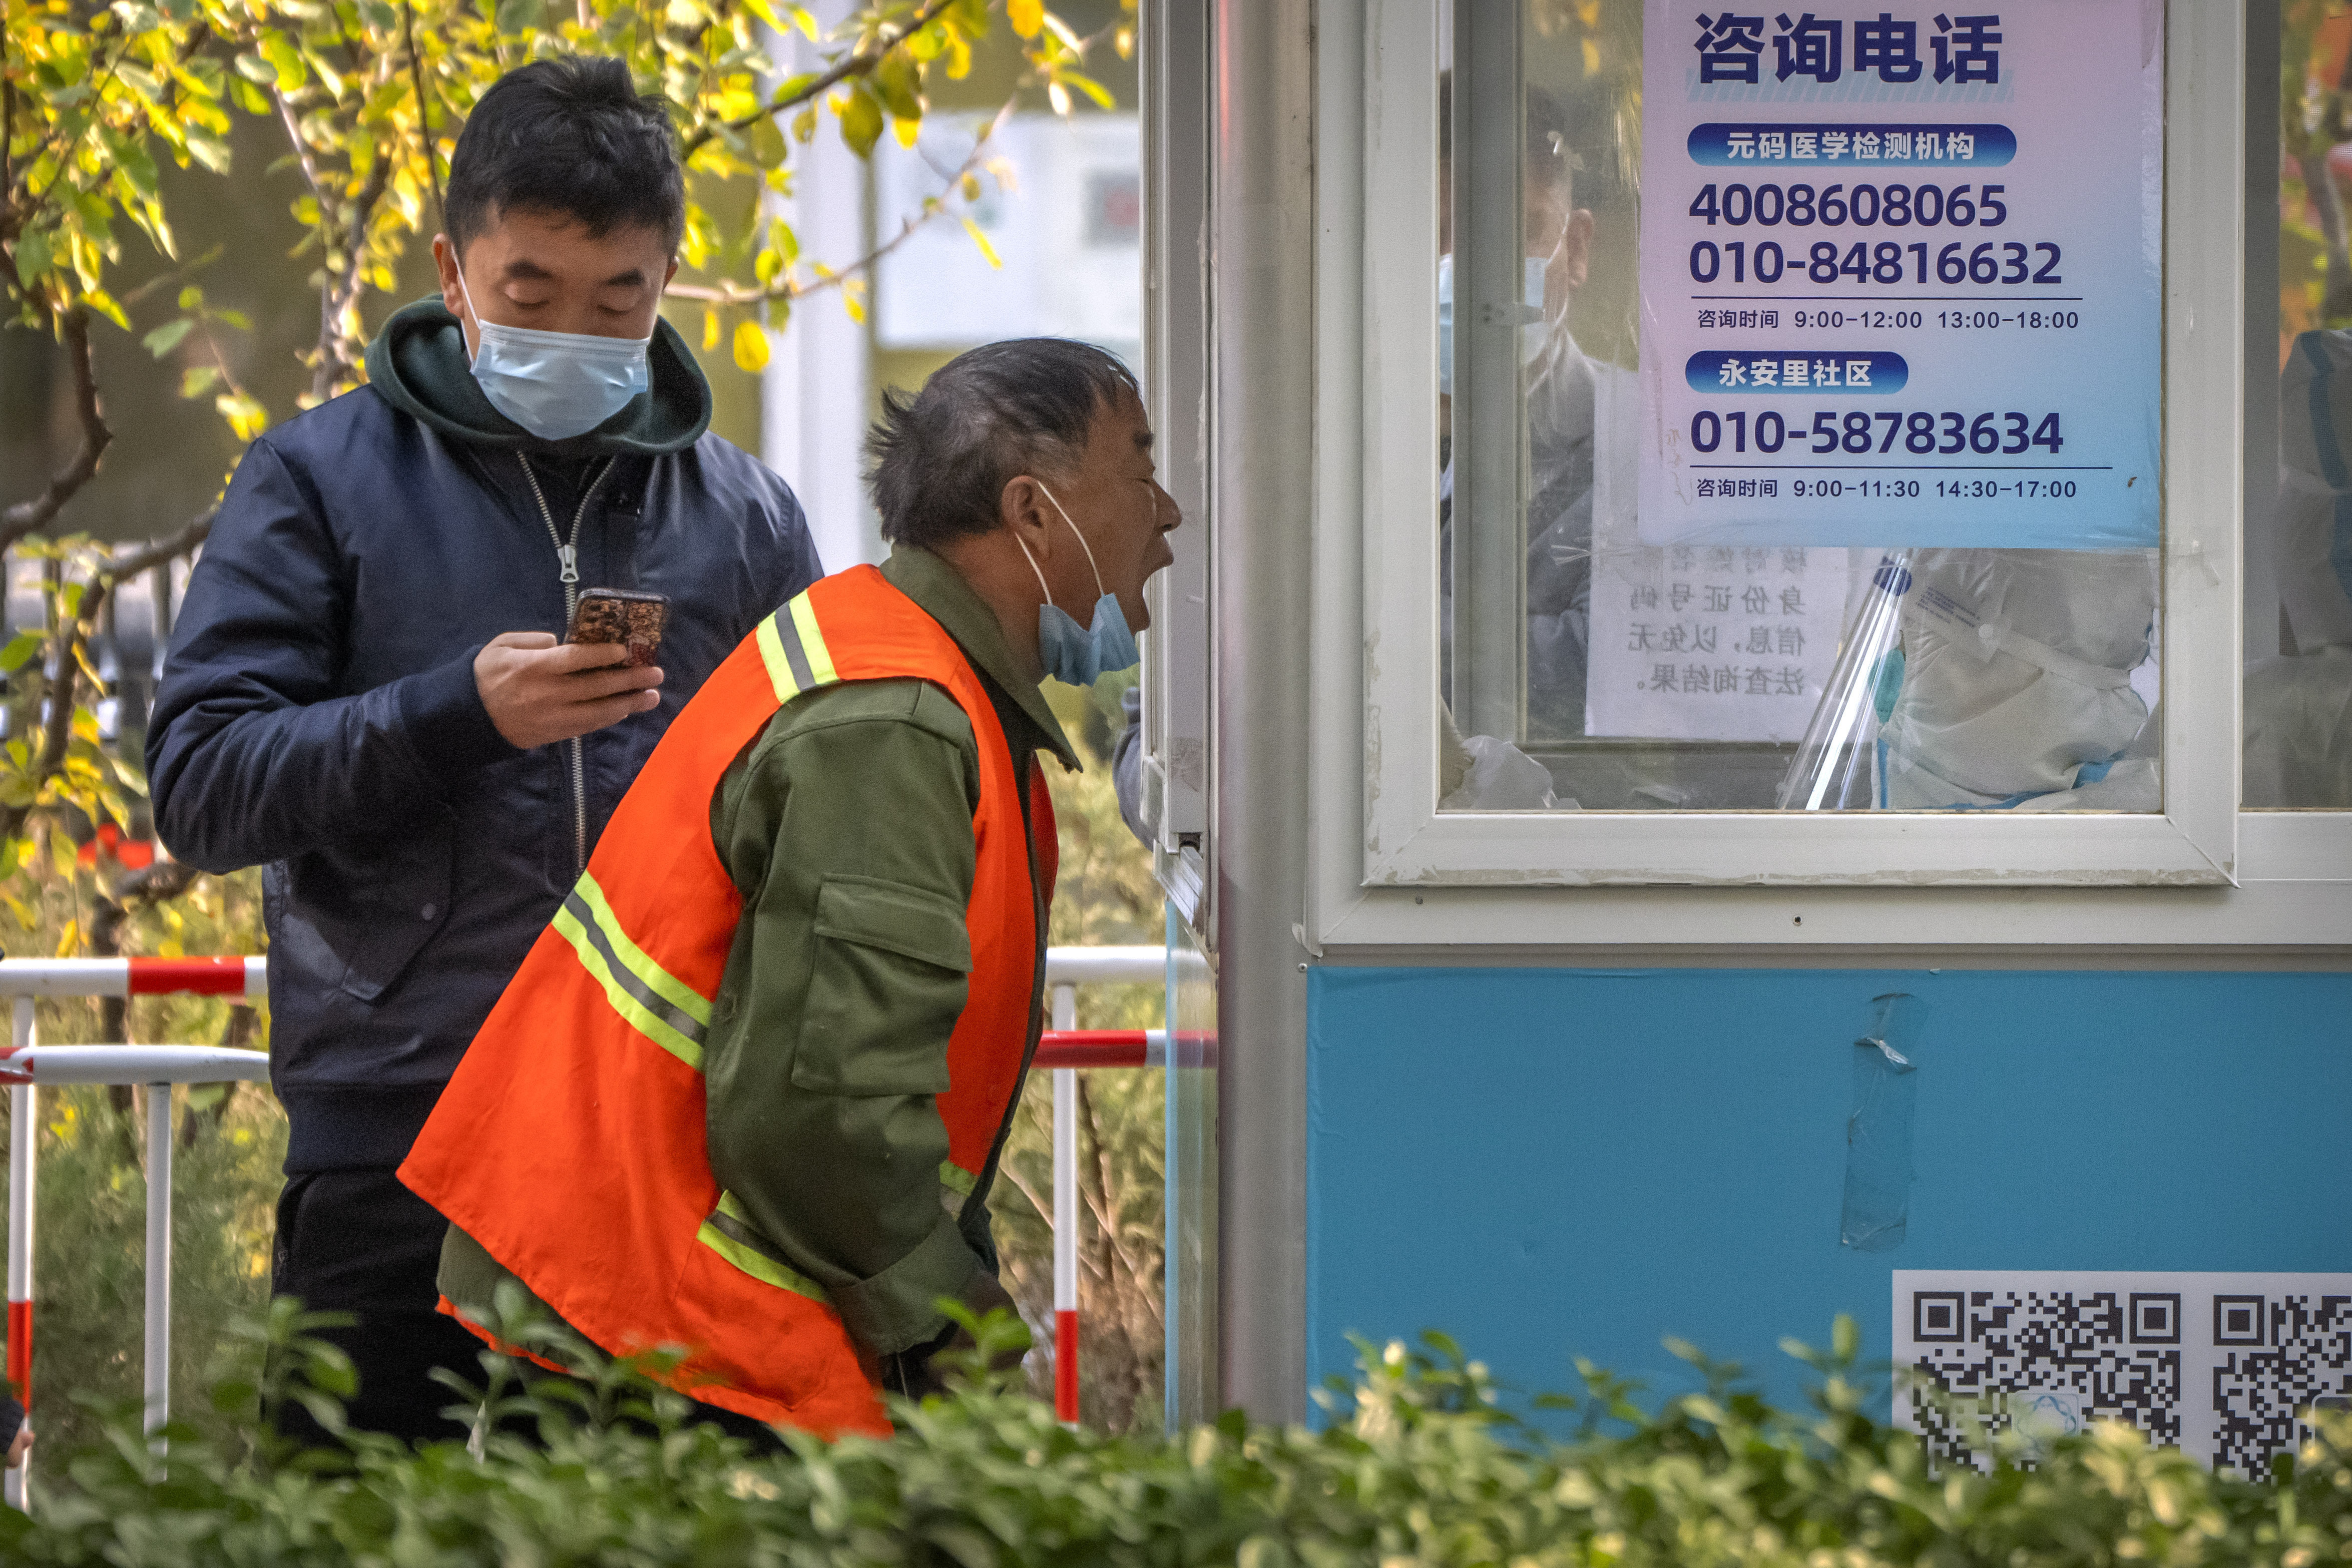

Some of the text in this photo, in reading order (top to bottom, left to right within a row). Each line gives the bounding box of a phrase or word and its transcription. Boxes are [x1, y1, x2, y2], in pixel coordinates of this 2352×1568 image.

[1694, 13, 2002, 84] 咨询电话
[1726, 132, 1975, 161] 元码医学检测机构
[1689, 183, 2007, 227] 4008608065
[1689, 241, 2062, 284] 010-84816632
[1697, 309, 2079, 329] 咨询时间 9:00-12:00 13:00-18:00
[1719, 359, 1872, 387] 永安里社区
[1690, 410, 2064, 454] 010-58783634
[1696, 478, 2077, 498] 咨询时间 9:00-11:30 14:30-17:00
